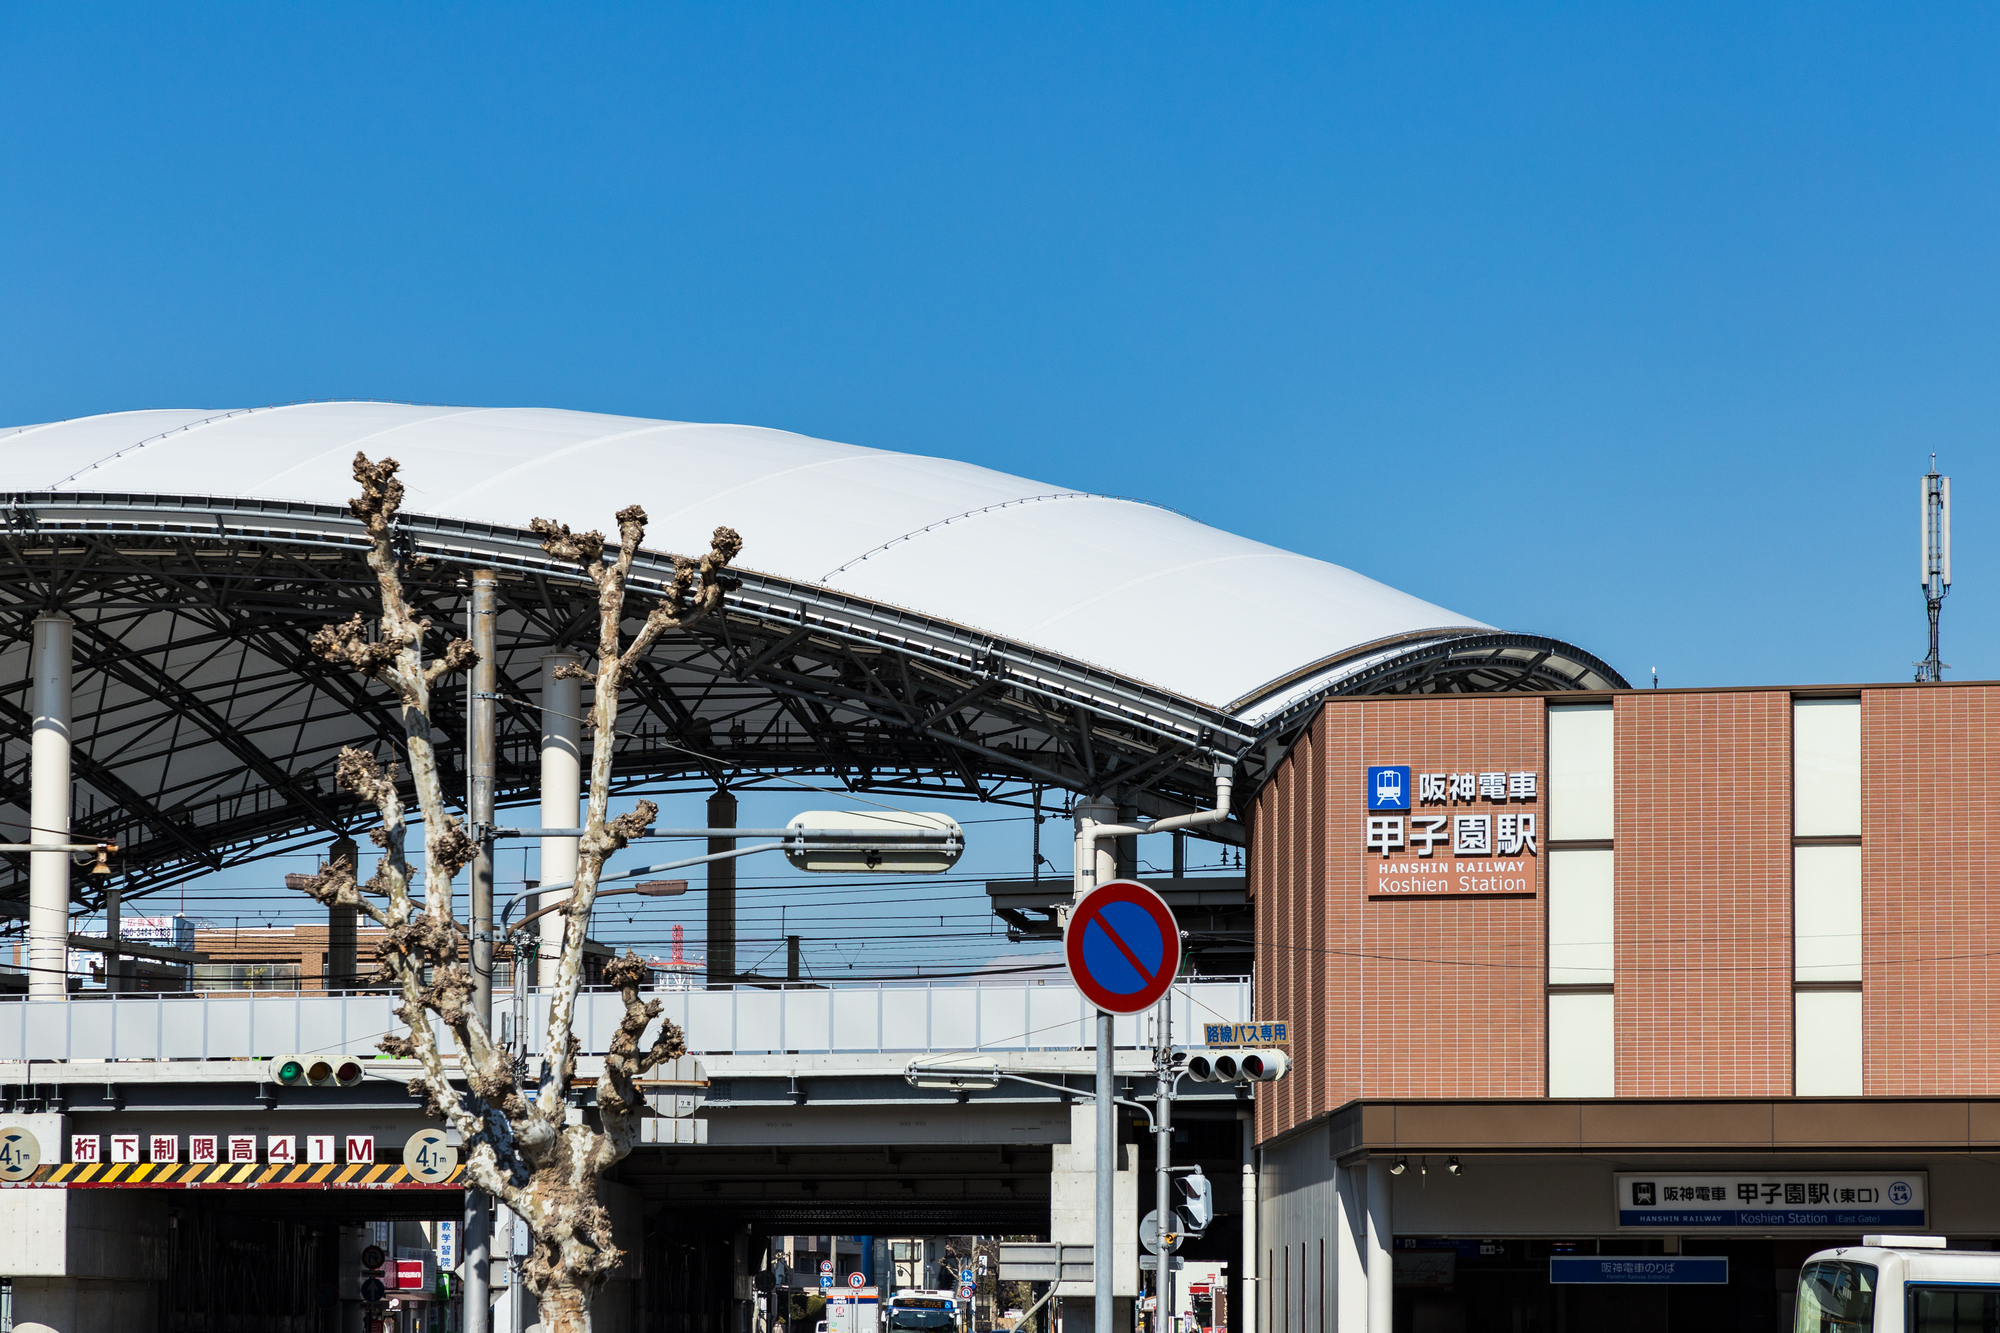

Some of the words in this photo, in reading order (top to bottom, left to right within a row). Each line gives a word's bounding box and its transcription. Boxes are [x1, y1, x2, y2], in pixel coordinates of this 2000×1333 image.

[1419, 772, 1537, 801] 阪神電車
[1366, 813, 1537, 856] 甲子園駅
[1379, 863, 1448, 874] HANSHIN
[1456, 862, 1525, 873] RAILWAY
[1379, 877, 1448, 892] Koshien
[1459, 876, 1526, 891] Station
[1206, 1024, 1287, 1043] 路線バス専用
[415, 1144, 447, 1167] 4.1m
[1663, 1186, 1727, 1201] 阪神電車
[1893, 1193, 1908, 1201] 14
[1741, 1213, 1785, 1224] Koshien
[1788, 1212, 1828, 1224] Station
[1835, 1214, 1856, 1224] (East
[1858, 1214, 1881, 1224] Gate)
[1601, 1262, 1676, 1273] 阪神電車のりば
